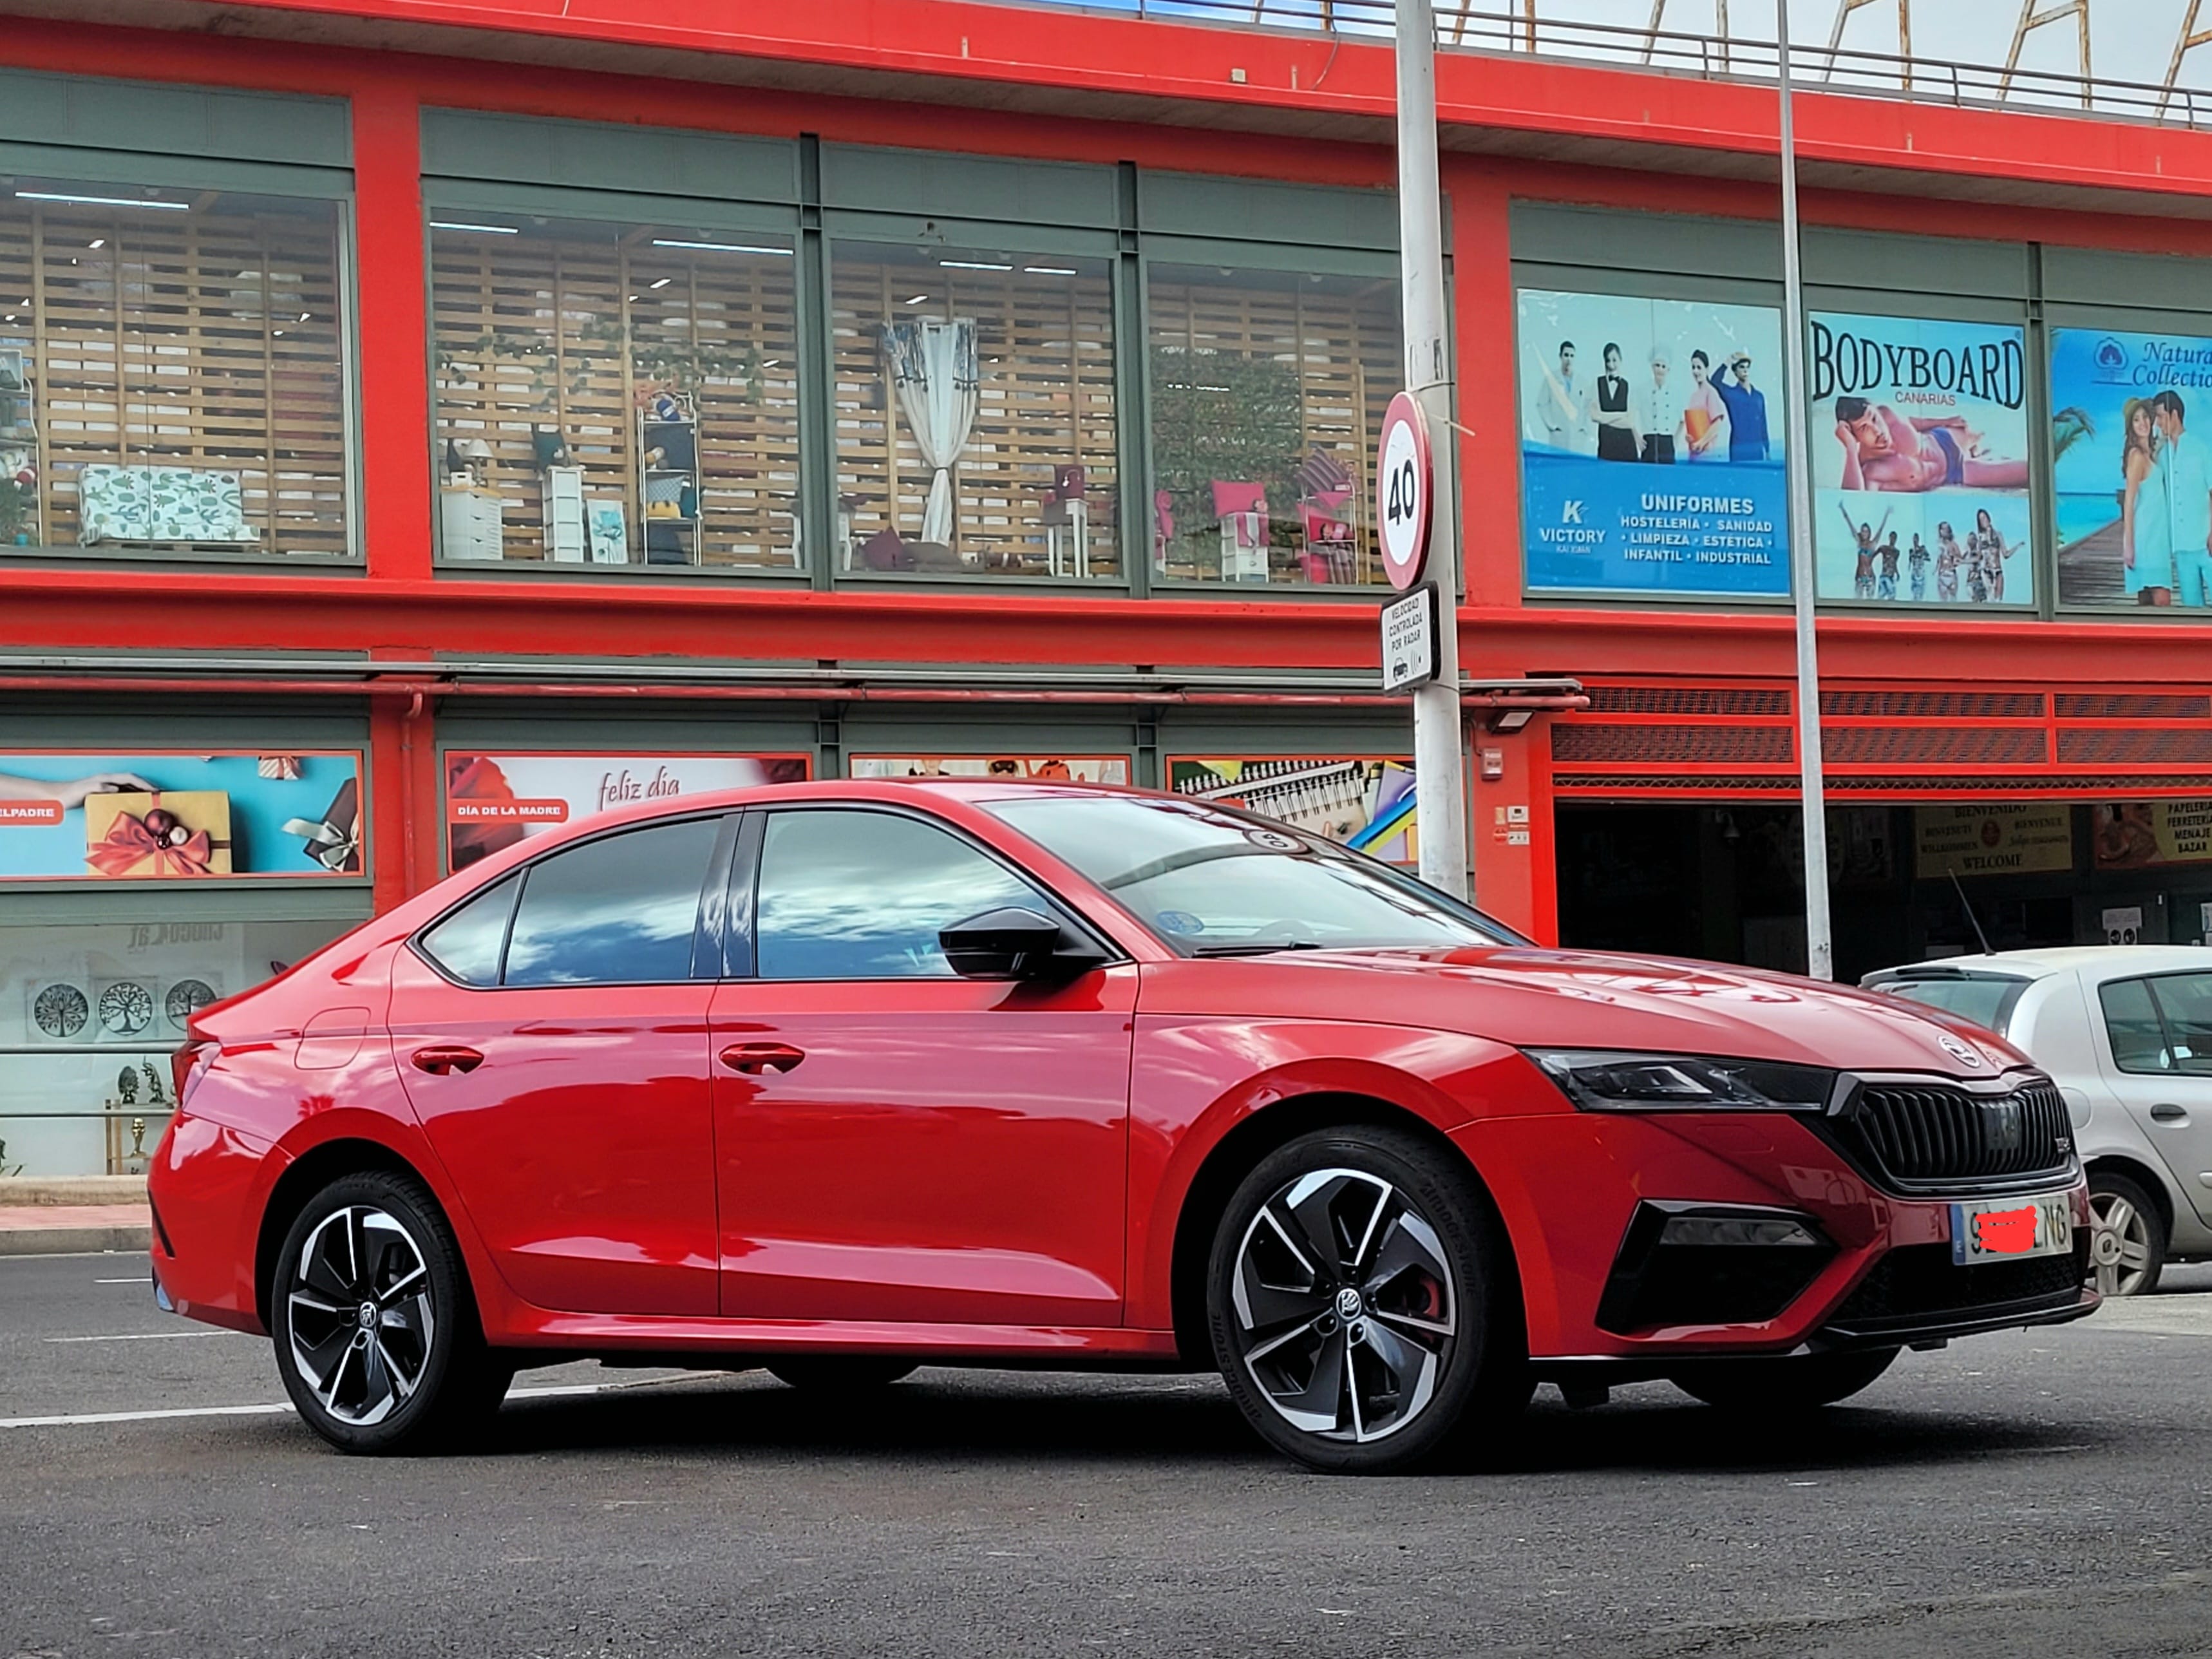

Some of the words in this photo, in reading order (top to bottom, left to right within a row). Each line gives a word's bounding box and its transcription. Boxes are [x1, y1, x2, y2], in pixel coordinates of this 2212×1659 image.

[1810, 320, 2025, 410] BODYBOARD
[1895, 392, 1956, 406] CANARIAS
[1388, 459, 1415, 526] 40
[1641, 493, 1754, 515] UNIFORMES
[1621, 515, 1700, 530] HOSTELERÍA
[1717, 519, 1772, 533] SANIDAD
[1539, 527, 1606, 544] VICTORY
[1631, 533, 1690, 546] LIMPIEZA
[1703, 535, 1763, 547] ESTÉTICA
[1625, 548, 1683, 562] INFANTIL
[1696, 551, 1772, 564] INDUSTRIAL
[1392, 637, 1402, 652] POR
[458, 805, 479, 815] DÍA
[482, 806, 498, 815] DE
[500, 806, 516, 815] LA
[519, 806, 561, 815] MADRE
[2175, 827, 2210, 840] MENAJE
[2178, 842, 2207, 853] BAZAR
[1963, 854, 2023, 870] WELCOME
